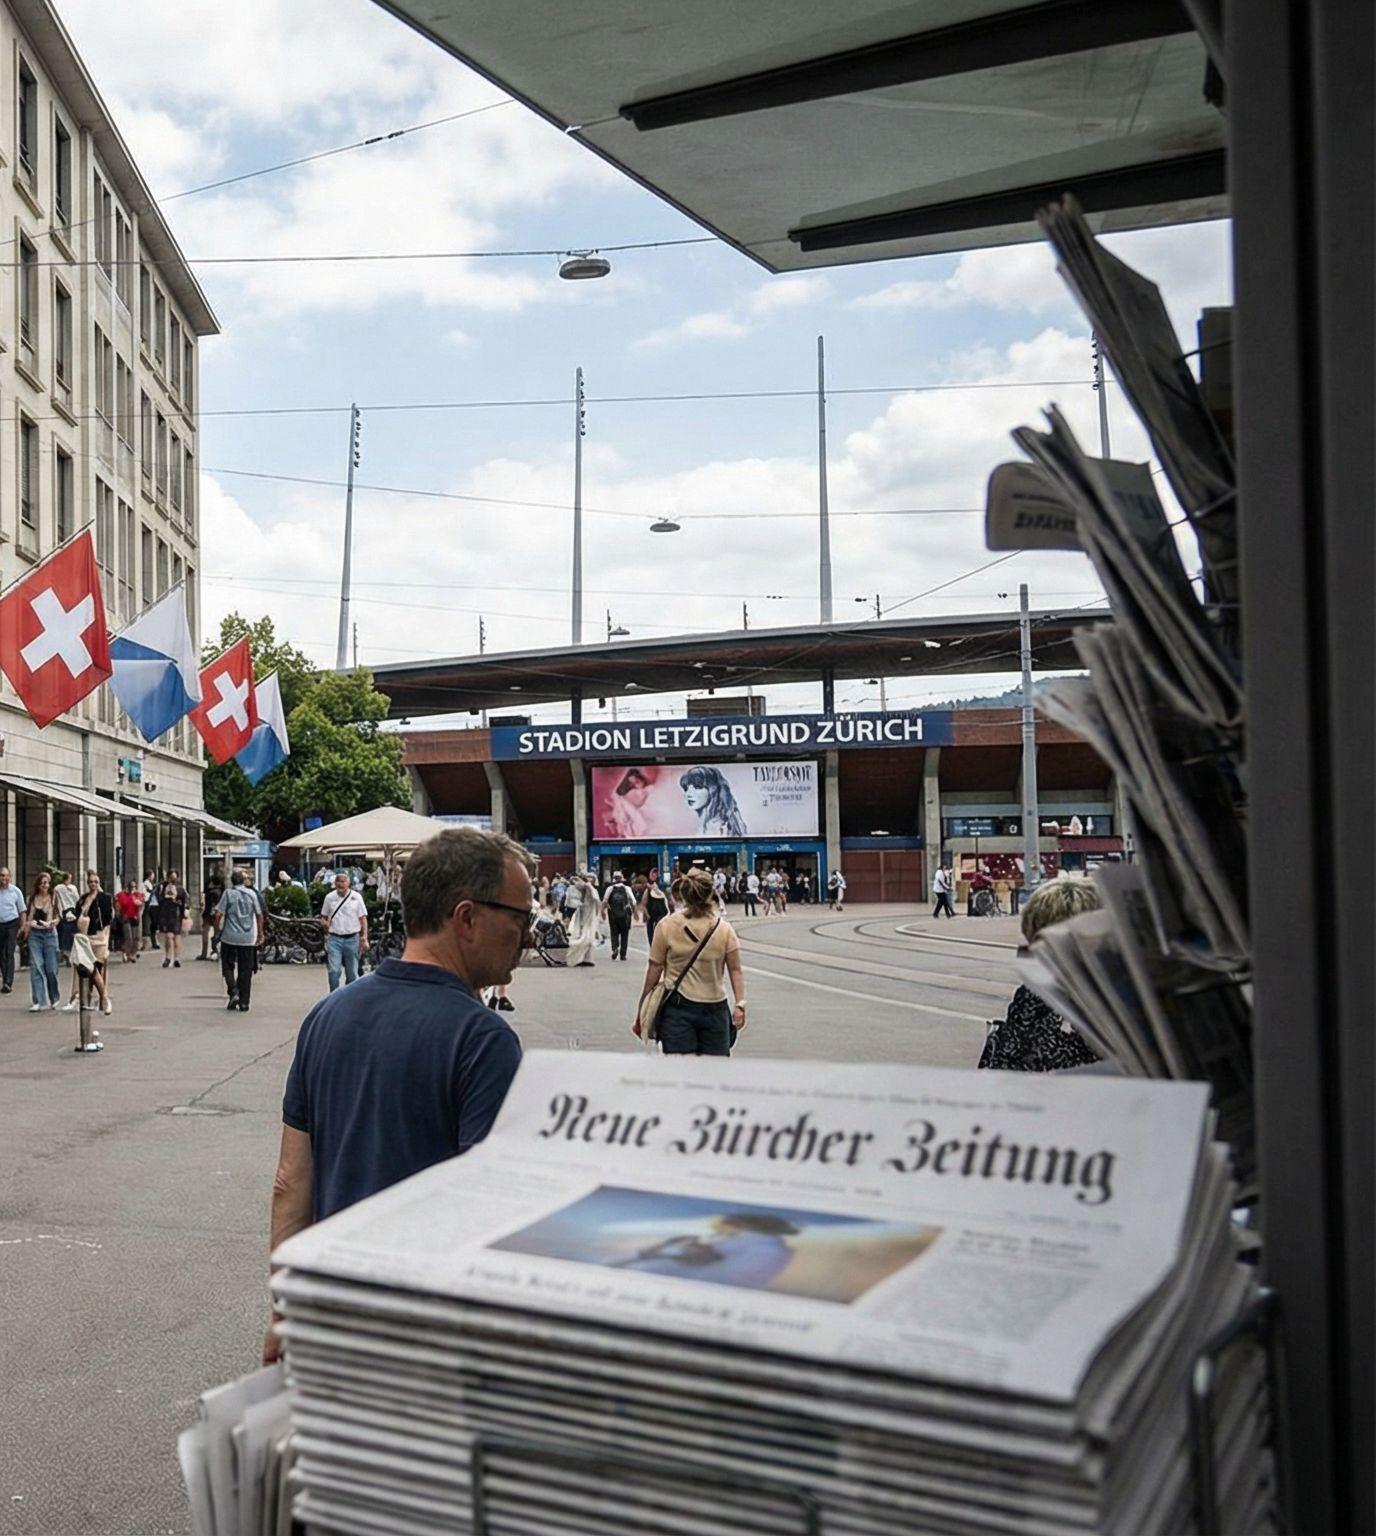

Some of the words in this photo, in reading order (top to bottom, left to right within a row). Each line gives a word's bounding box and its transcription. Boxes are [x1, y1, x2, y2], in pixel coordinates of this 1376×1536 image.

[519, 728, 632, 753] STADION
[639, 721, 811, 749] LETZIGRUND
[816, 714, 924, 743] ZÜRICH
[538, 1094, 661, 1148] Neue
[667, 1104, 874, 1169] Zürcher
[882, 1118, 1118, 1206] Zeitung
